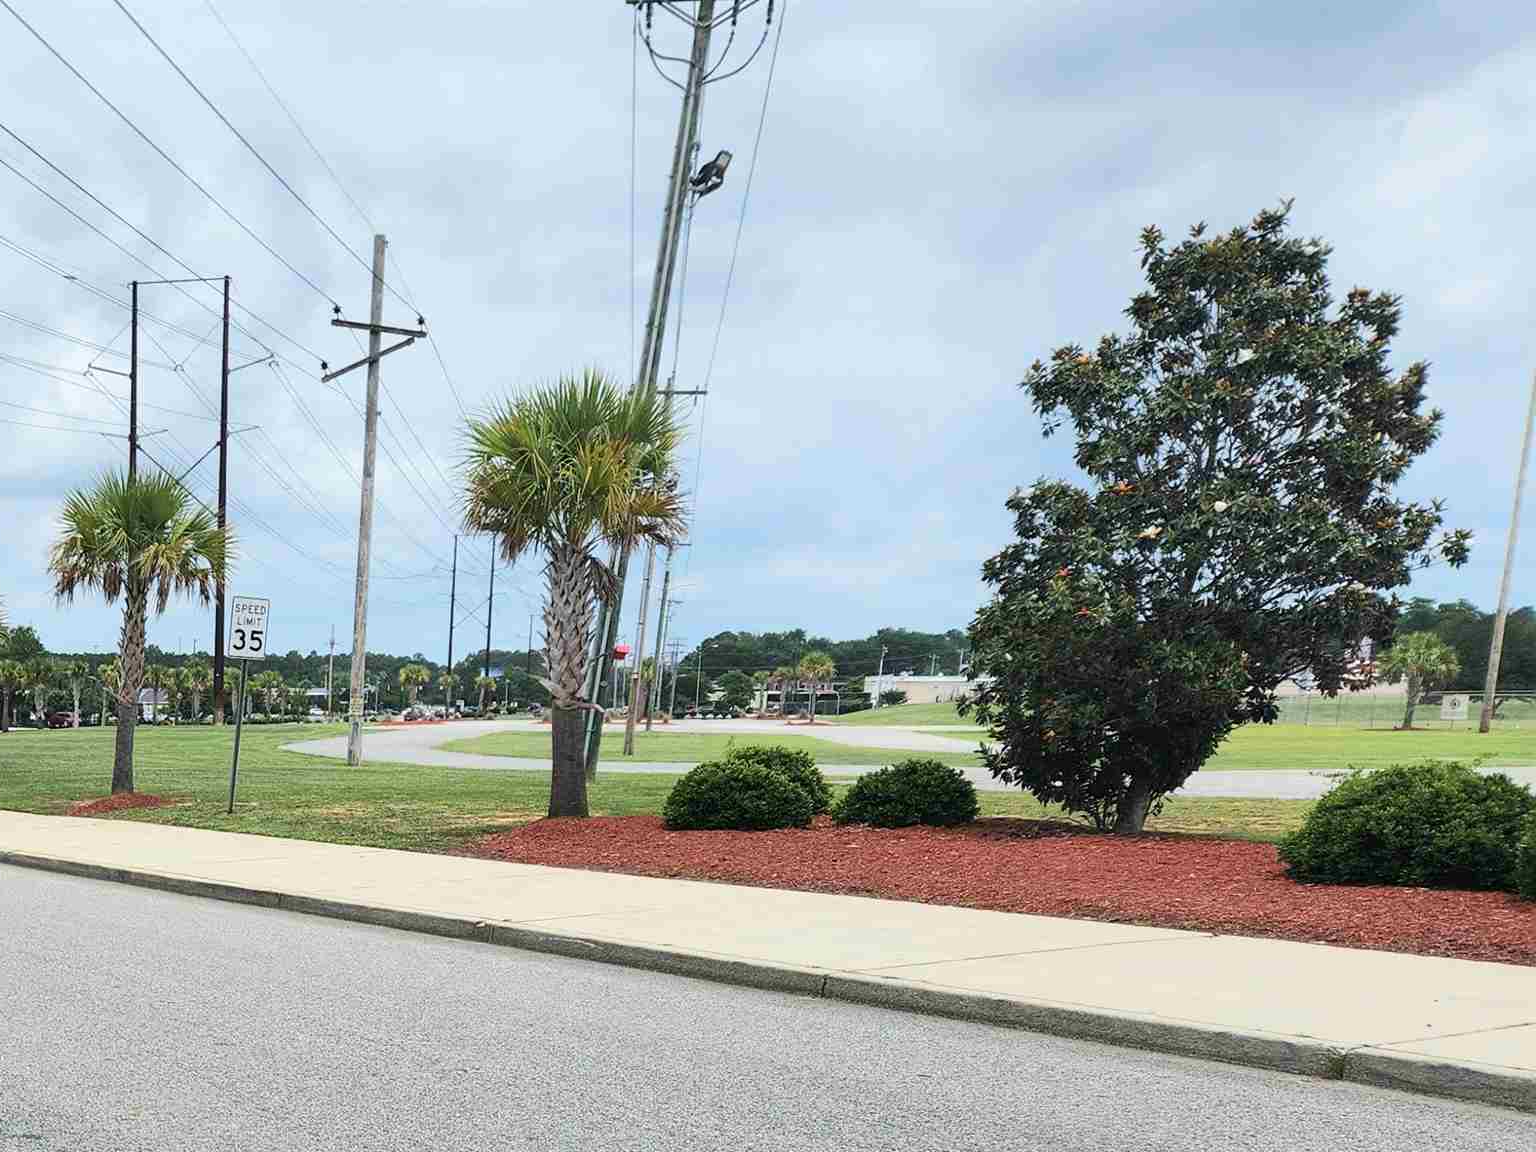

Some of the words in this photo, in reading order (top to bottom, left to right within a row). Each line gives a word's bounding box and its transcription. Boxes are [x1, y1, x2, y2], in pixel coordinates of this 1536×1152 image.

[235, 604, 266, 615] SPEED
[237, 615, 262, 627] LIMIT
[233, 629, 263, 651] 35
